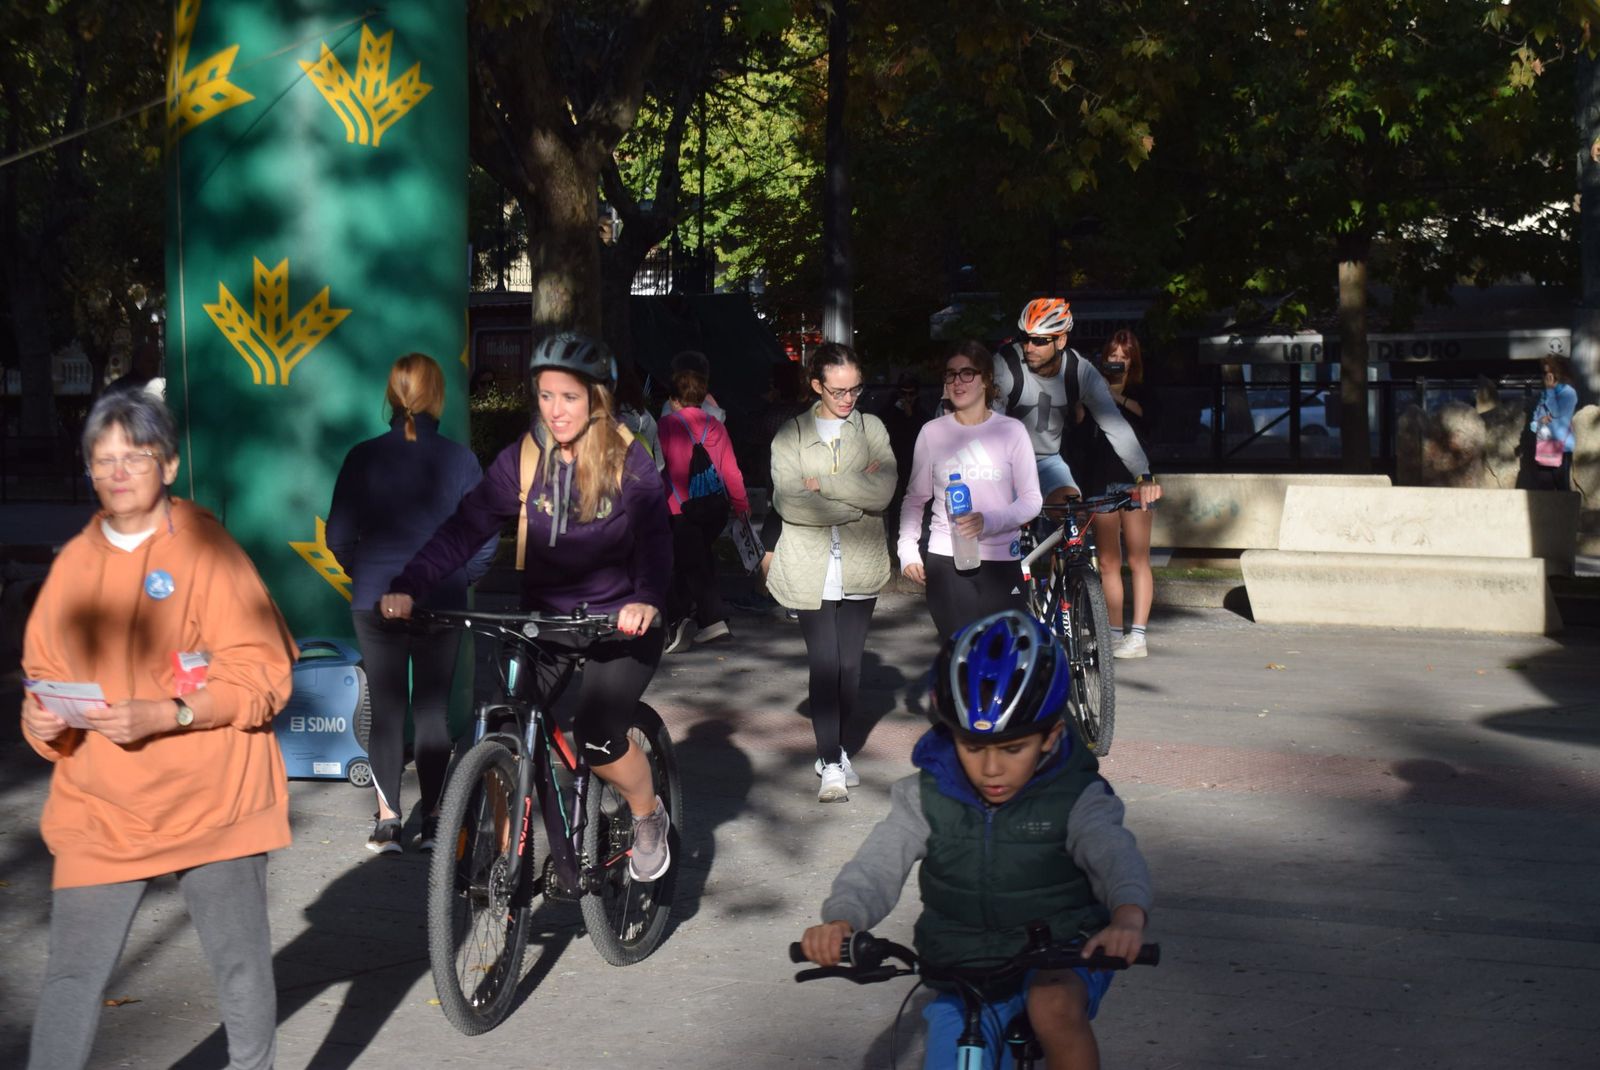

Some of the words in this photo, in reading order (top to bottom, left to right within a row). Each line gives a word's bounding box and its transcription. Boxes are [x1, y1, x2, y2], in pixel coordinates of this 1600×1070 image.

[1283, 343, 1302, 362] LA
[1378, 342, 1404, 360] DE
[1412, 340, 1461, 360] ORO
[938, 464, 1002, 482] adidas
[307, 716, 346, 733] SDMO
